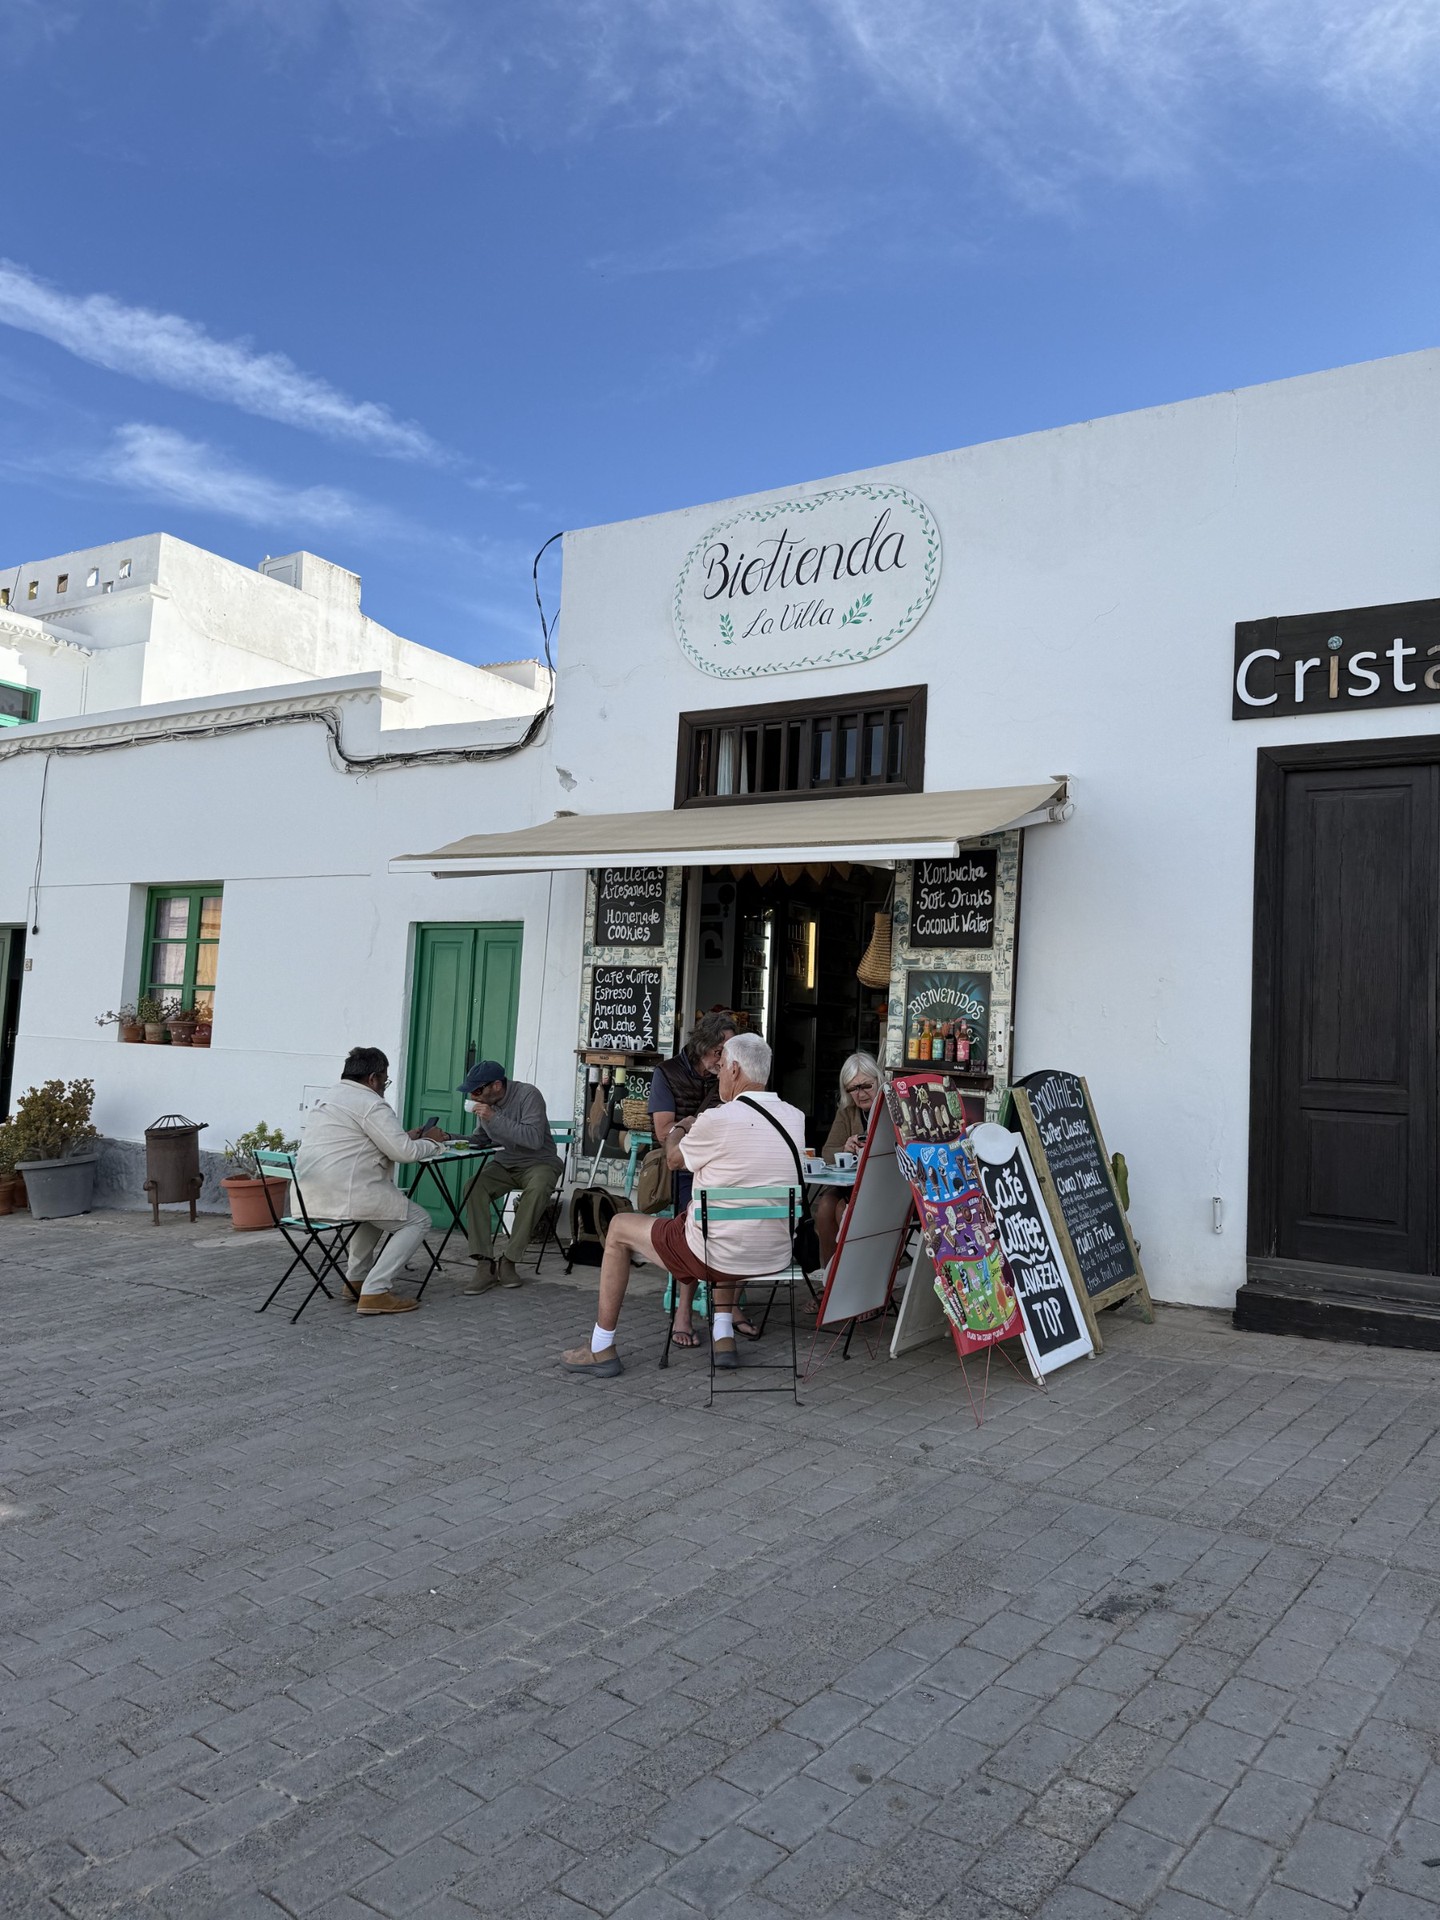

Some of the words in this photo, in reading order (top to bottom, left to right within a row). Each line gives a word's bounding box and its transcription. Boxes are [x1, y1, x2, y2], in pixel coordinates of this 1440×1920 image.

[742, 608, 774, 639] La
[780, 599, 834, 631] Villa
[605, 866, 664, 884] Galletas
[920, 860, 987, 885] Kombucha
[601, 882, 662, 899] Artesanales
[920, 888, 946, 910] Soft
[947, 887, 993, 908] Drinks
[917, 913, 960, 935] Coconut
[961, 911, 993, 933] Water
[596, 968, 624, 986] Café
[630, 968, 660, 984] Coffee
[595, 986, 633, 1000] Espresso
[595, 1002, 637, 1016] Americano
[643, 985, 655, 1048] LAVAZZA
[594, 1017, 609, 1031] Con
[611, 1017, 637, 1032] Leche
[1060, 1116, 1090, 1140] Classic
[981, 1161, 1028, 1211] Café
[1056, 1176, 1077, 1196] Choco
[1074, 1168, 1102, 1190] Muesli
[995, 1211, 1044, 1254] Coffee
[1014, 1261, 1063, 1298] LAVAZZA
[1032, 1297, 1064, 1339] TOP
